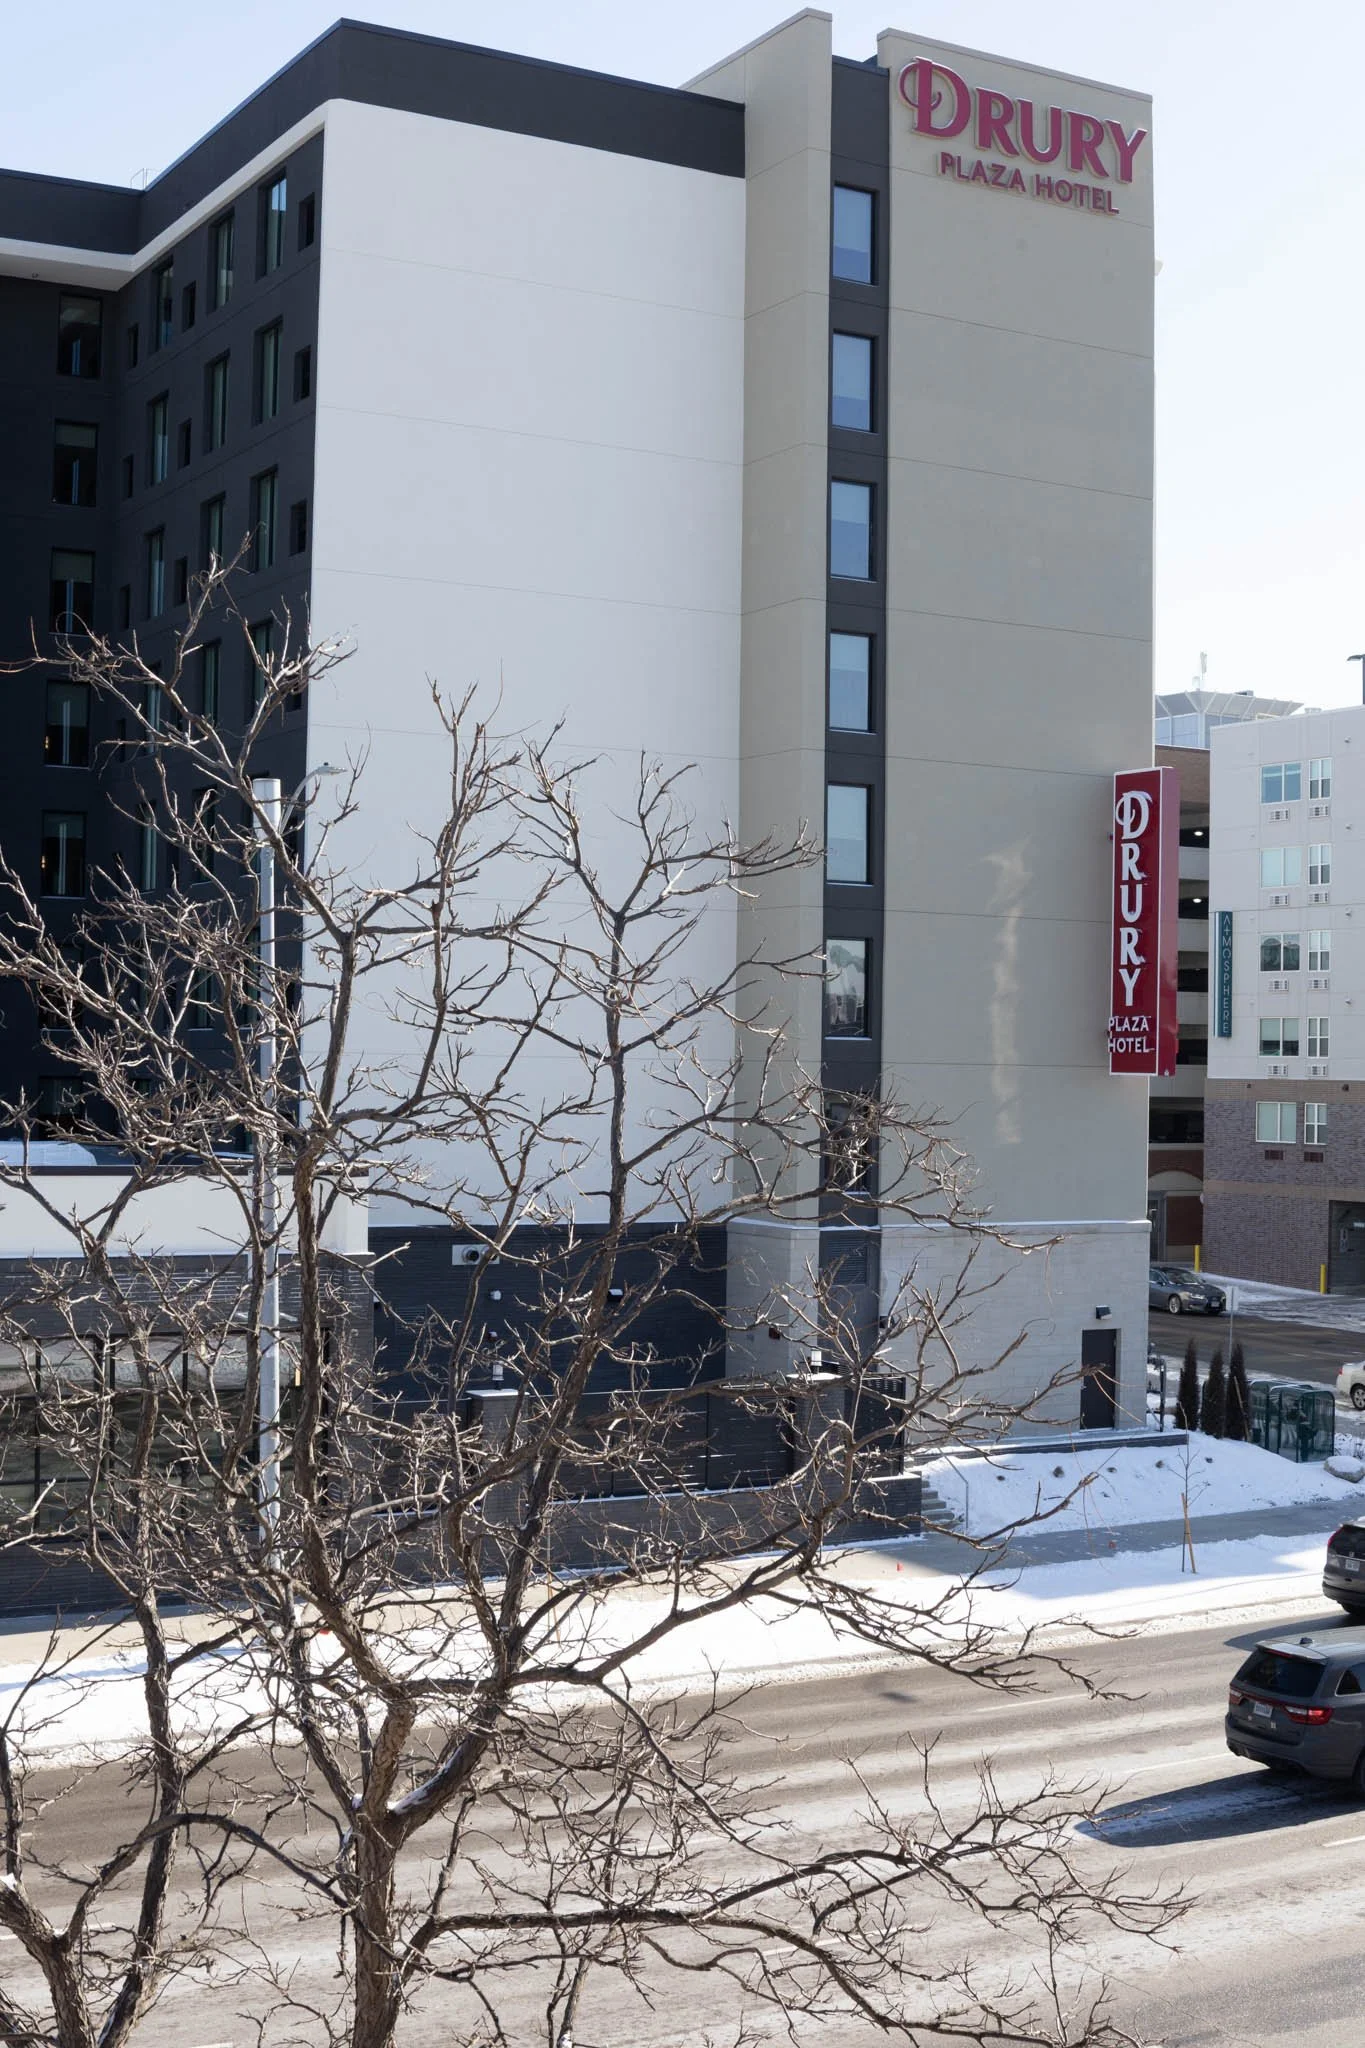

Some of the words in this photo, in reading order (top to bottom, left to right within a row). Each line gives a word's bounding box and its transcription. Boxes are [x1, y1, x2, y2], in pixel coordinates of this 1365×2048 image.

[899, 55, 1148, 184] DRURY
[937, 151, 1027, 193] PLAZA
[1032, 173, 1120, 215] HOTEL
[1115, 790, 1153, 1007] DRURY
[1222, 914, 1232, 1034] ATMOSPHERE
[1107, 1037, 1151, 1053] HOTEL
[1108, 1016, 1150, 1031] PLAZA
